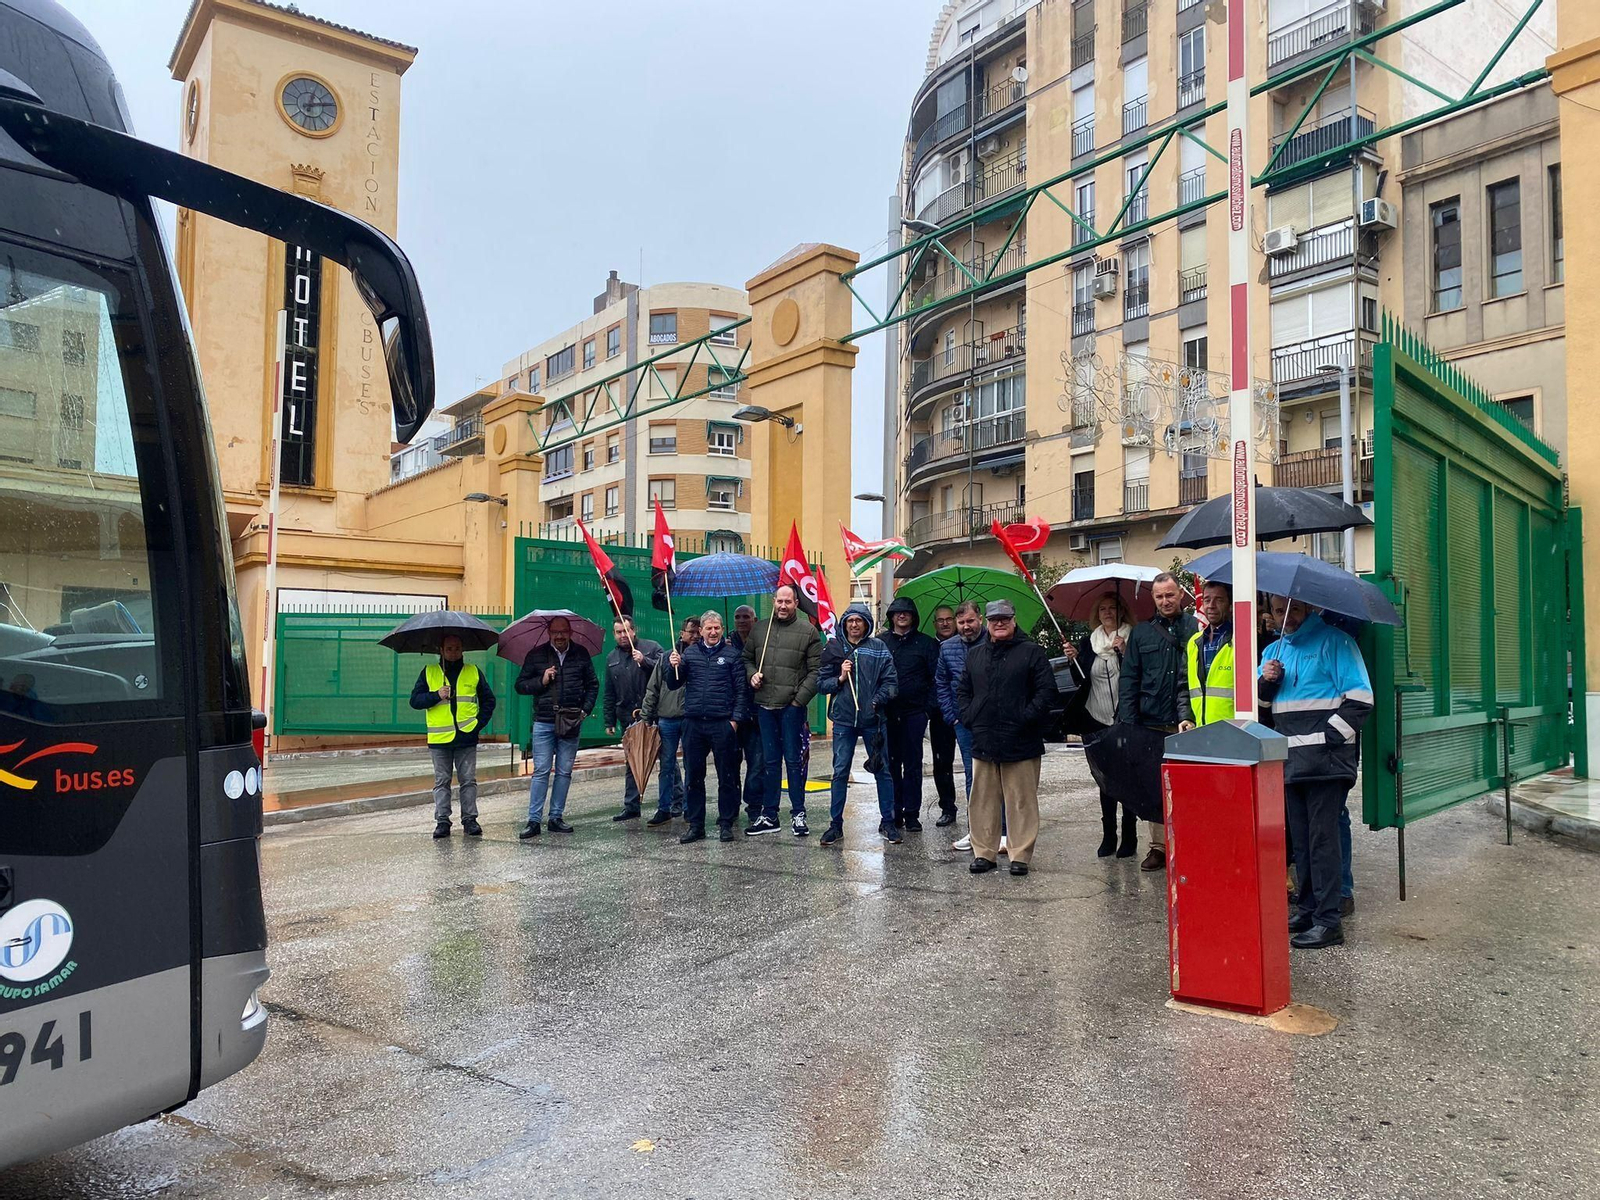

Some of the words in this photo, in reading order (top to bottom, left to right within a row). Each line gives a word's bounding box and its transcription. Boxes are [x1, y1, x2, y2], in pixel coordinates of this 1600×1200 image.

[359, 311, 374, 416] OBUSES
[1235, 440, 1247, 547] www.automatismosvilchez.com
[784, 559, 818, 603] CG
[55, 768, 135, 793] bus.es
[0, 984, 33, 999] RUPO
[33, 960, 78, 998] SAMAR
[0, 1010, 92, 1087] 941
